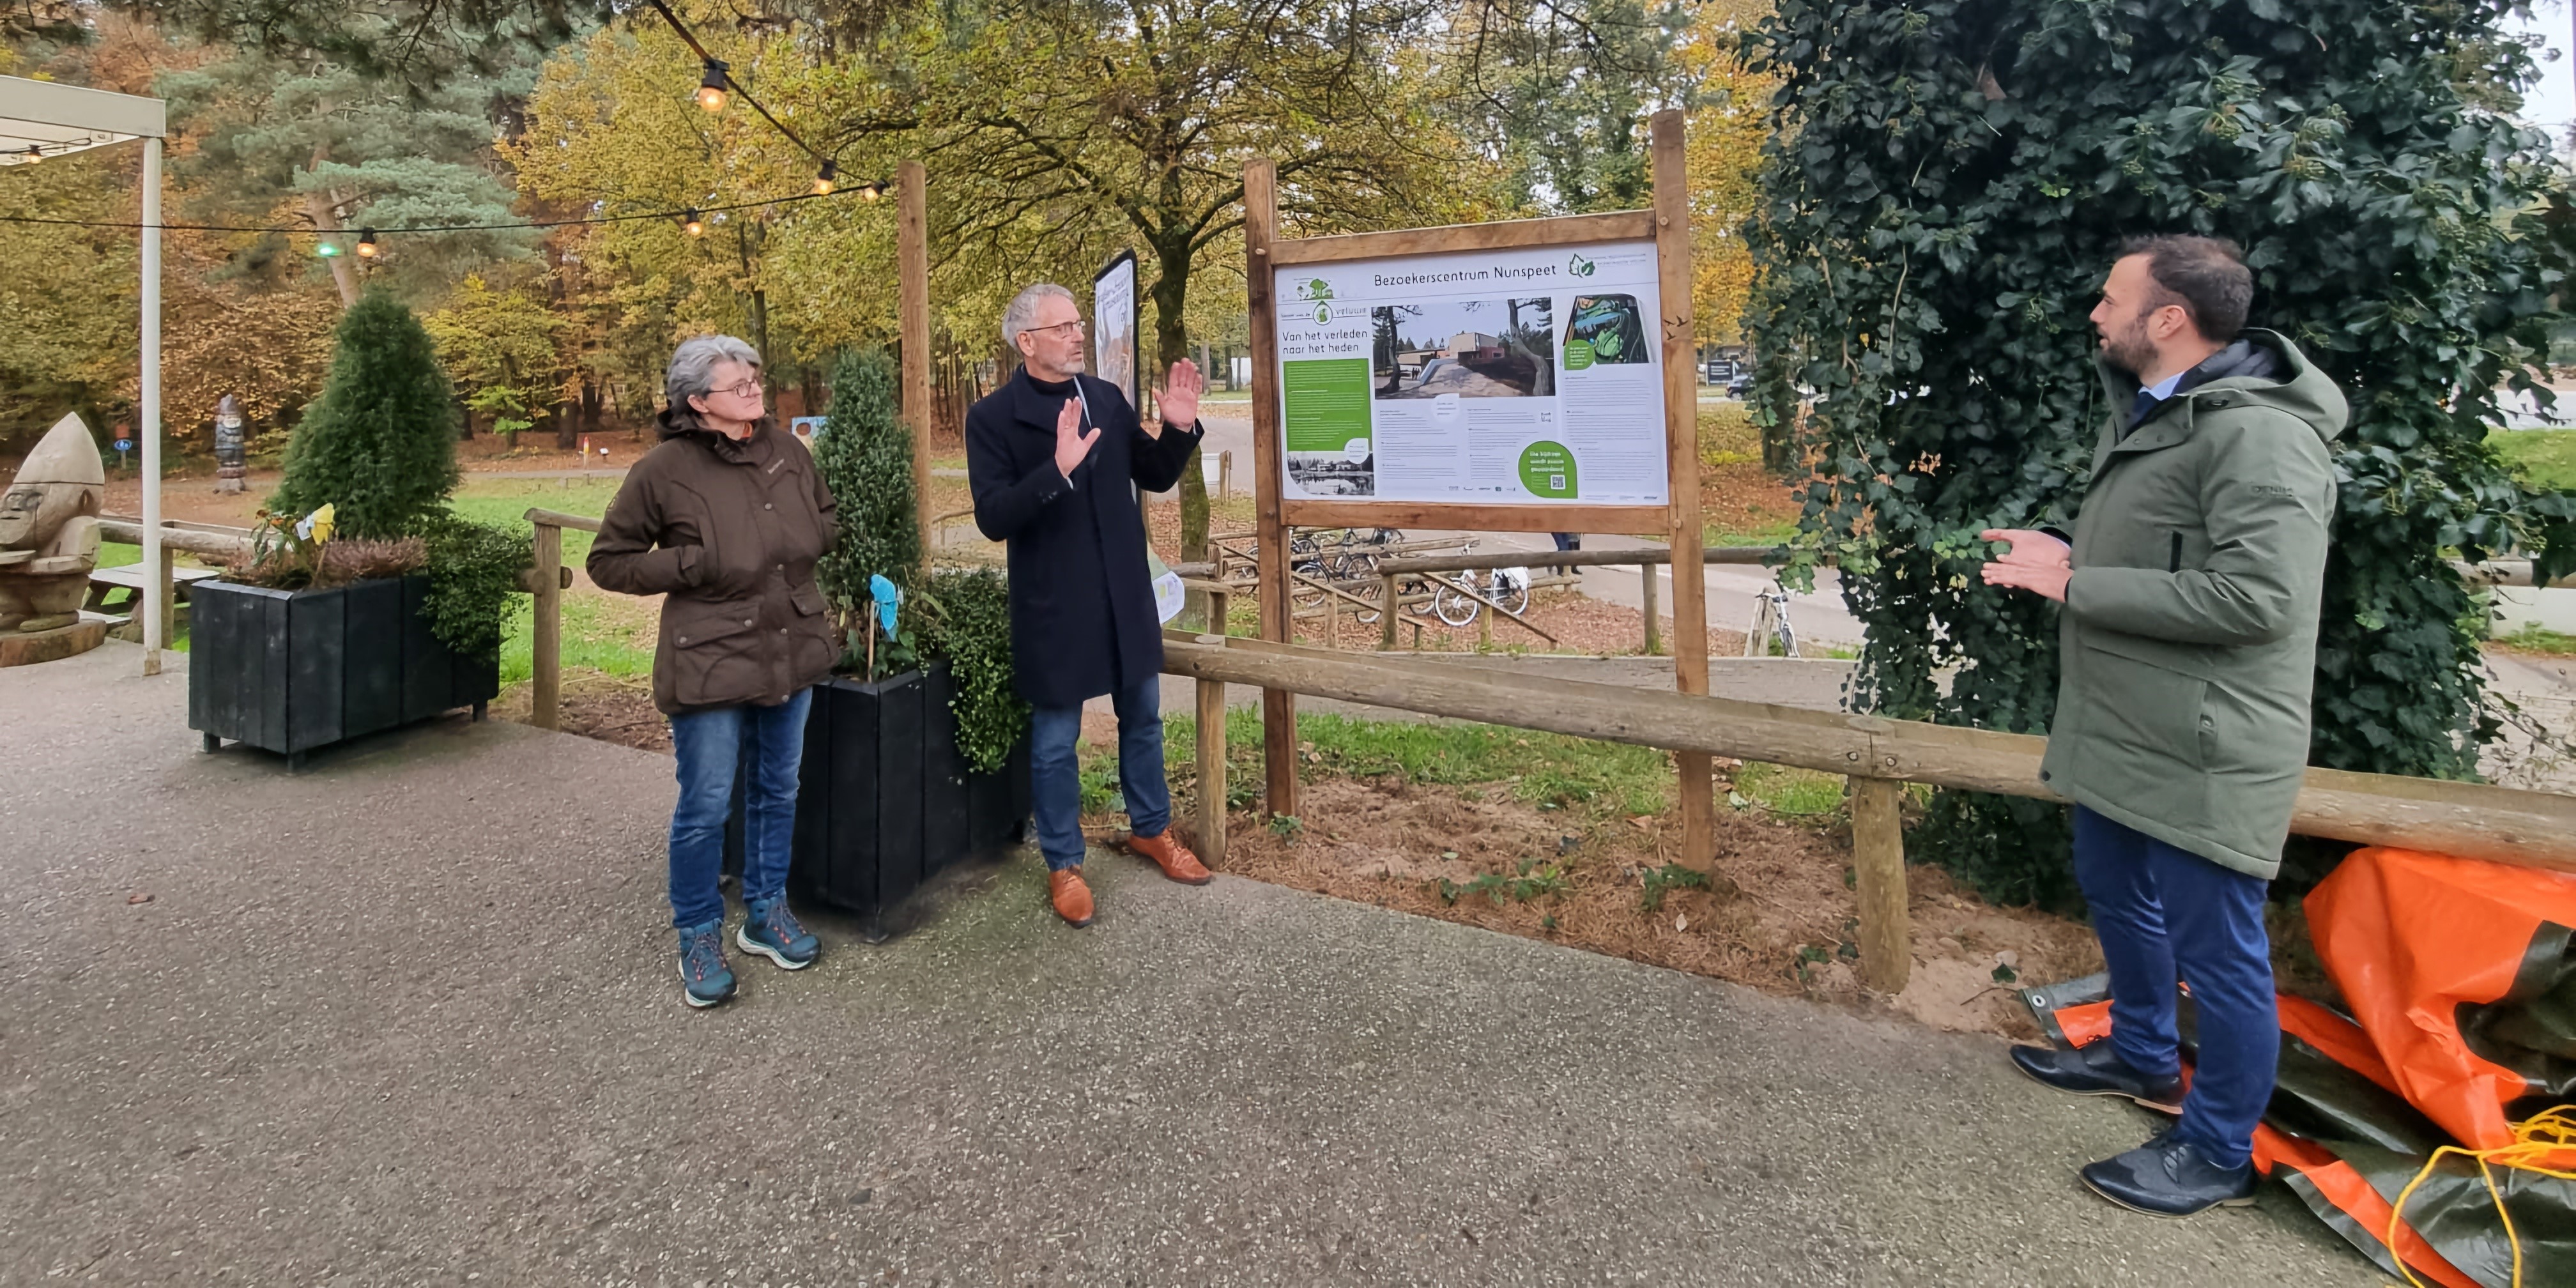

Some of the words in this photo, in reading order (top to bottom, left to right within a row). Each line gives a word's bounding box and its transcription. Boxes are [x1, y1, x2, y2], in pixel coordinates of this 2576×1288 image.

[1374, 271, 1489, 286] Bezoekerscentrum
[1494, 265, 1557, 280] Nunspeet
[1282, 332, 1301, 341] Van
[1305, 330, 1321, 341] het
[1324, 328, 1368, 340] verleden
[1308, 344, 1324, 353] het
